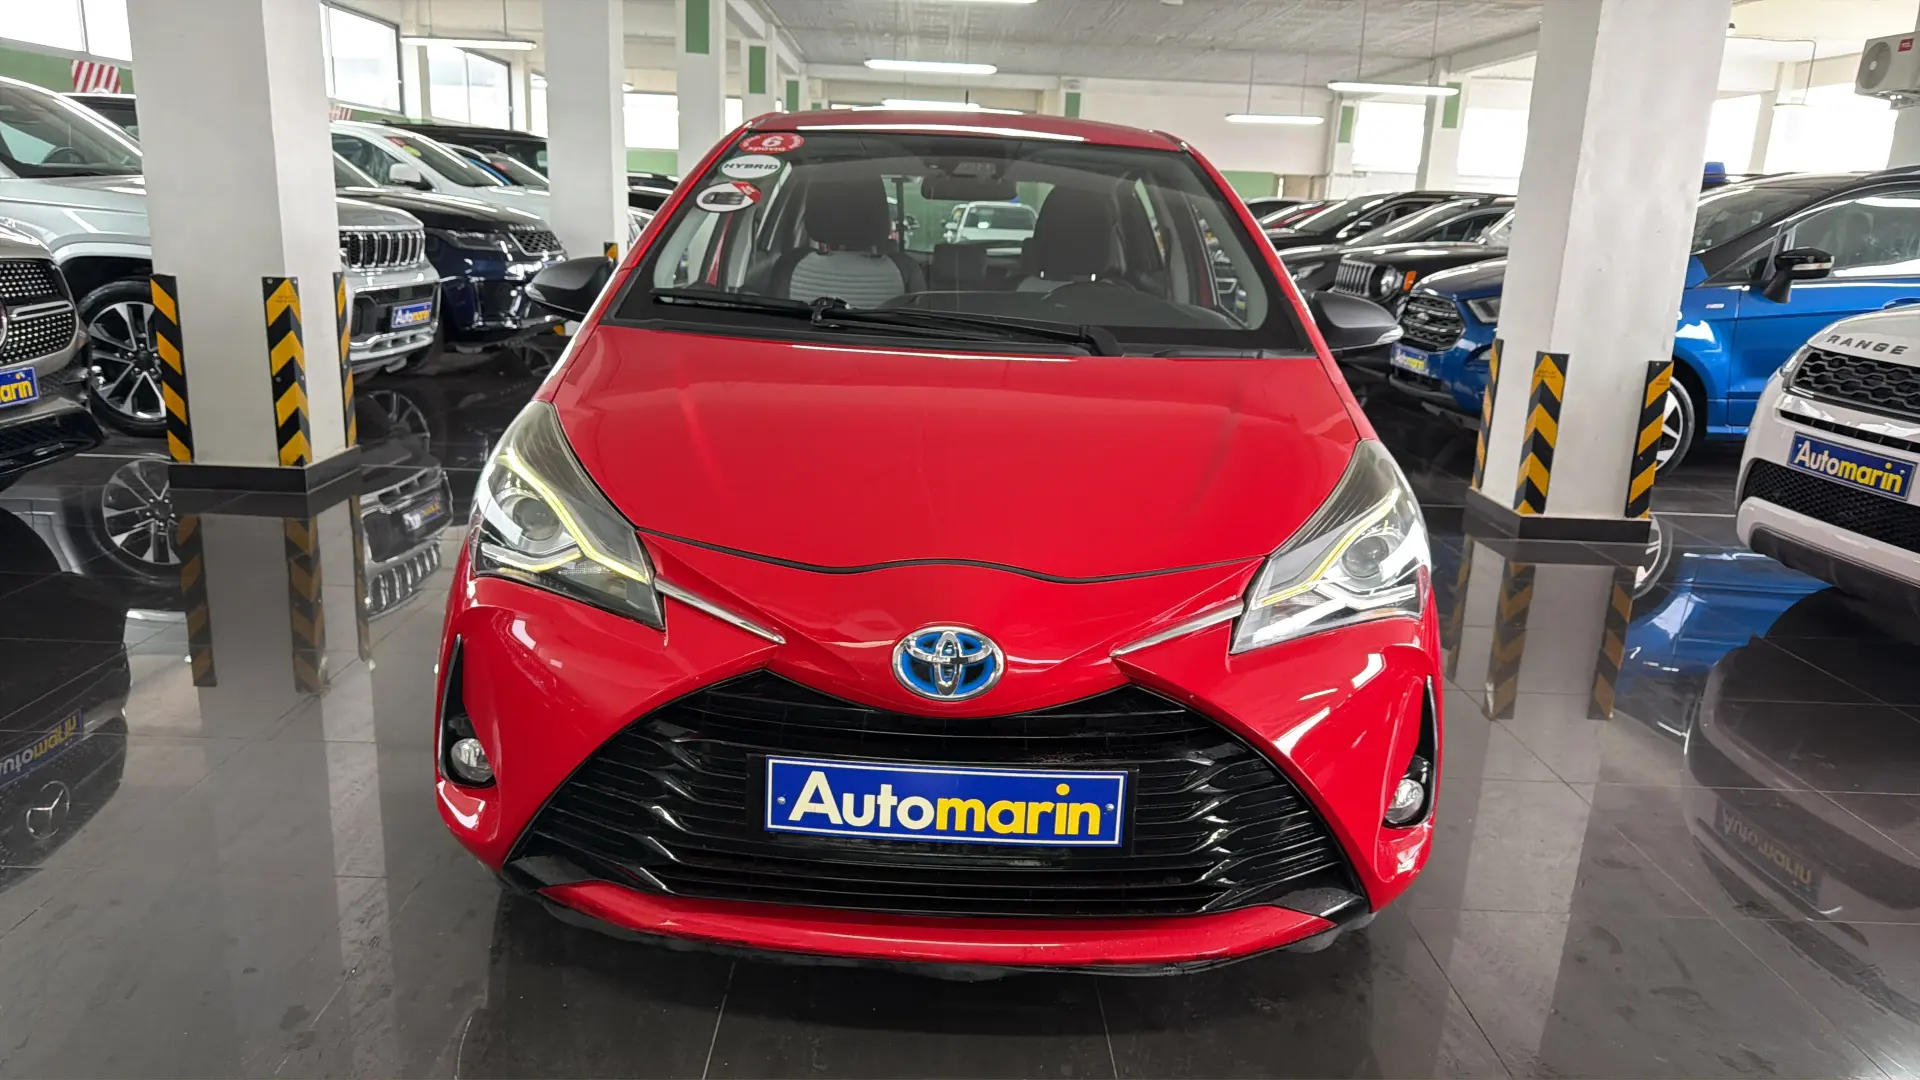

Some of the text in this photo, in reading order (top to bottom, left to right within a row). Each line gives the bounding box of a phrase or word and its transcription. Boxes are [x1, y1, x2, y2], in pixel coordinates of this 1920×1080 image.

[761, 135, 784, 147] 6
[1826, 334, 1909, 355] RANGE
[1793, 440, 1903, 494] Automarin
[788, 770, 1101, 835] Automarin
